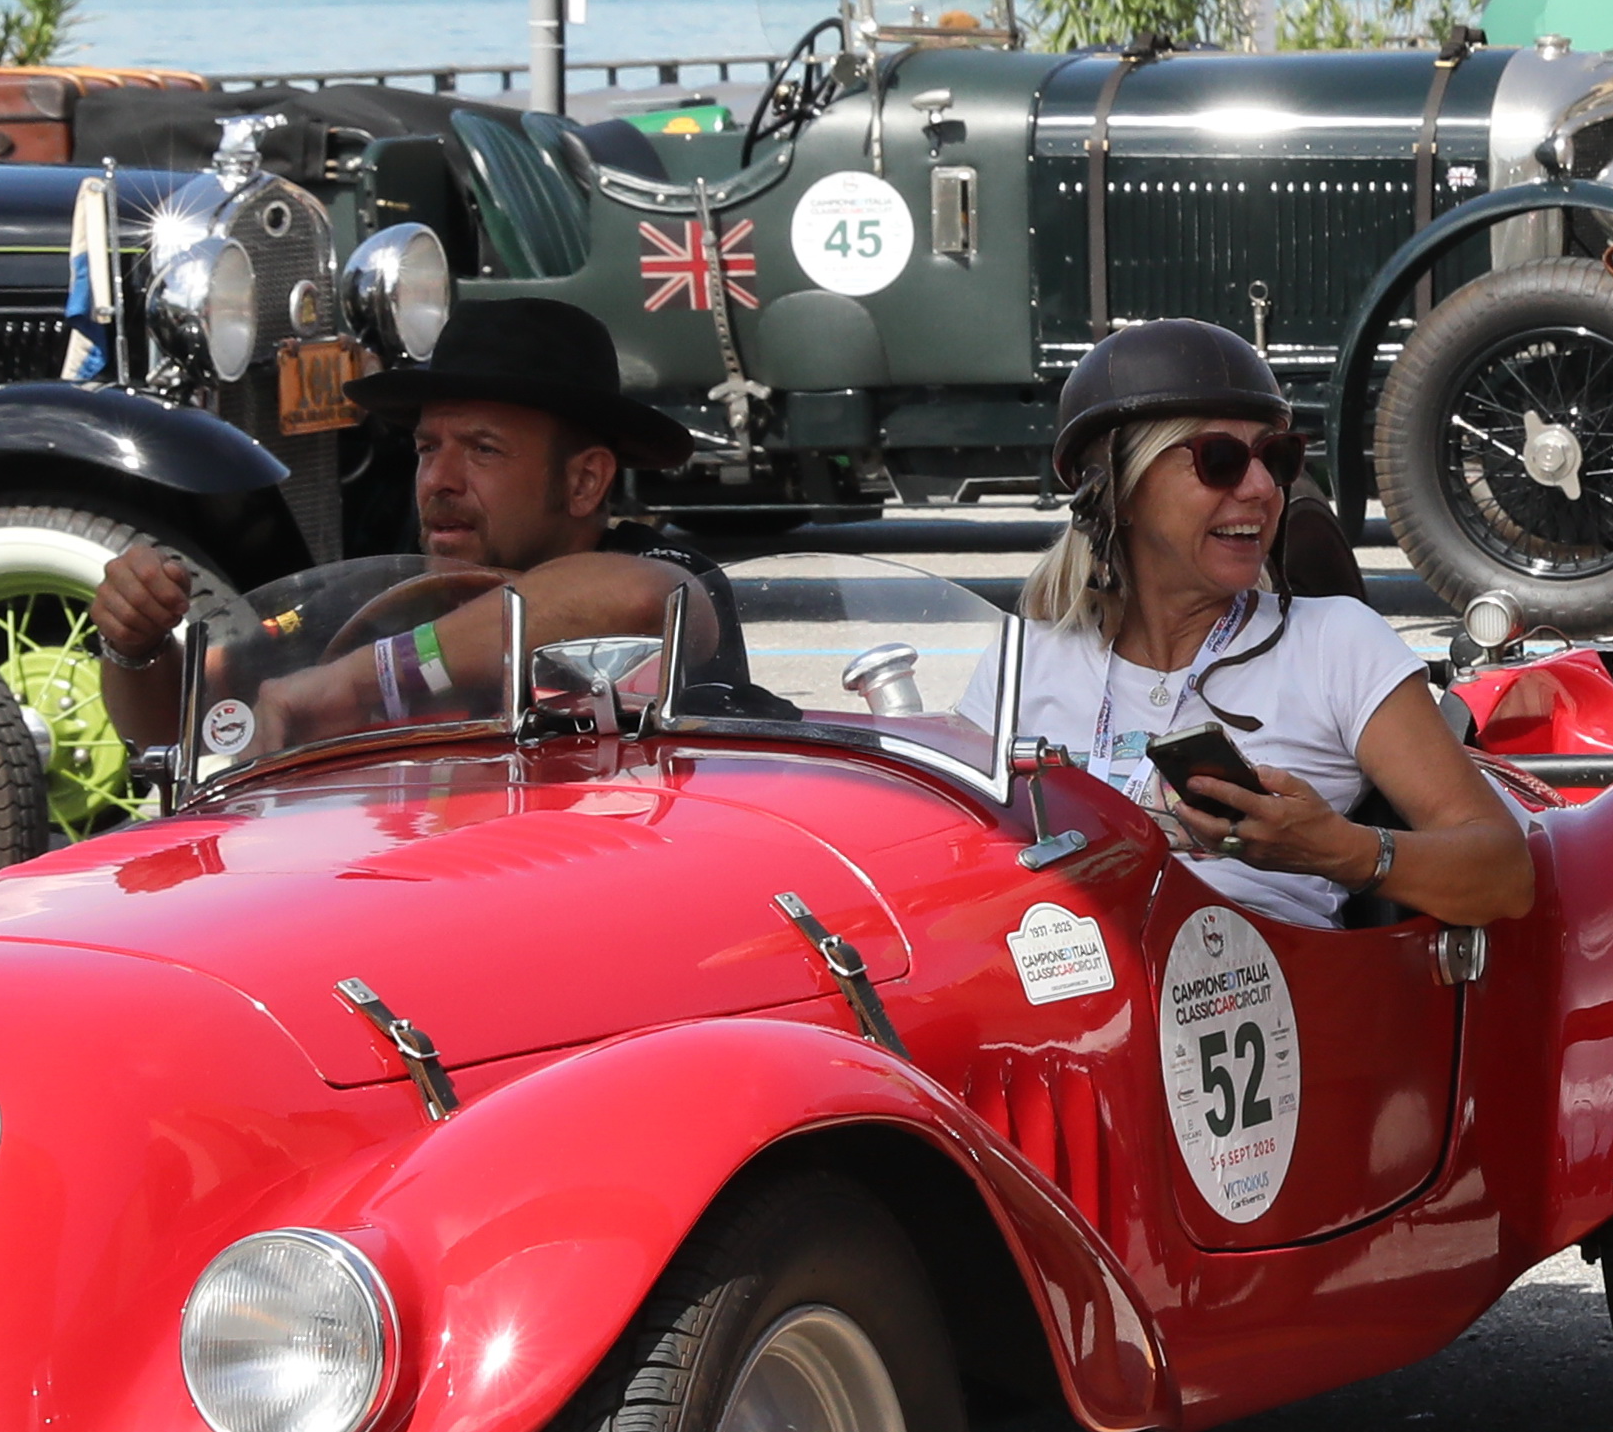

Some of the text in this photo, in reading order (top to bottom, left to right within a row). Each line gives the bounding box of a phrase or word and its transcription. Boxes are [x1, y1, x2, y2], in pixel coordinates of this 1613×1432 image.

[824, 219, 883, 258] 45
[1199, 1021, 1273, 1137] 52
[1228, 1145, 1251, 1166] SEPT
[1253, 1137, 1276, 1158] 2026
